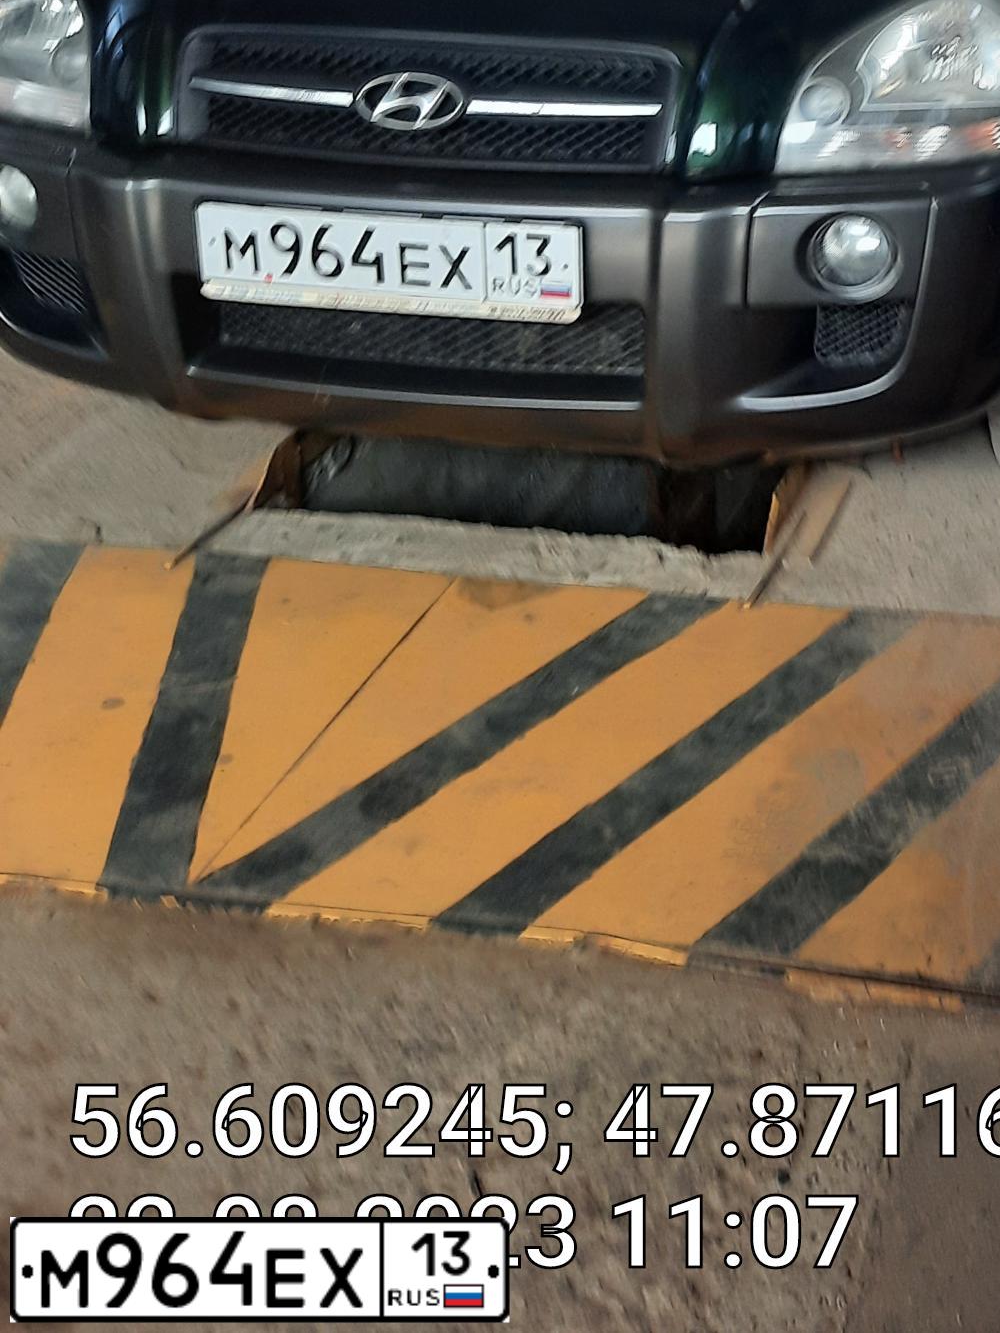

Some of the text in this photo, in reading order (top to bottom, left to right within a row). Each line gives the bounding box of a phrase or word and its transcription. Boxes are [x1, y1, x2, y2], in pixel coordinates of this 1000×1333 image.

[223, 220, 553, 290] М964ЕХ 13
[490, 276, 538, 298] RUS
